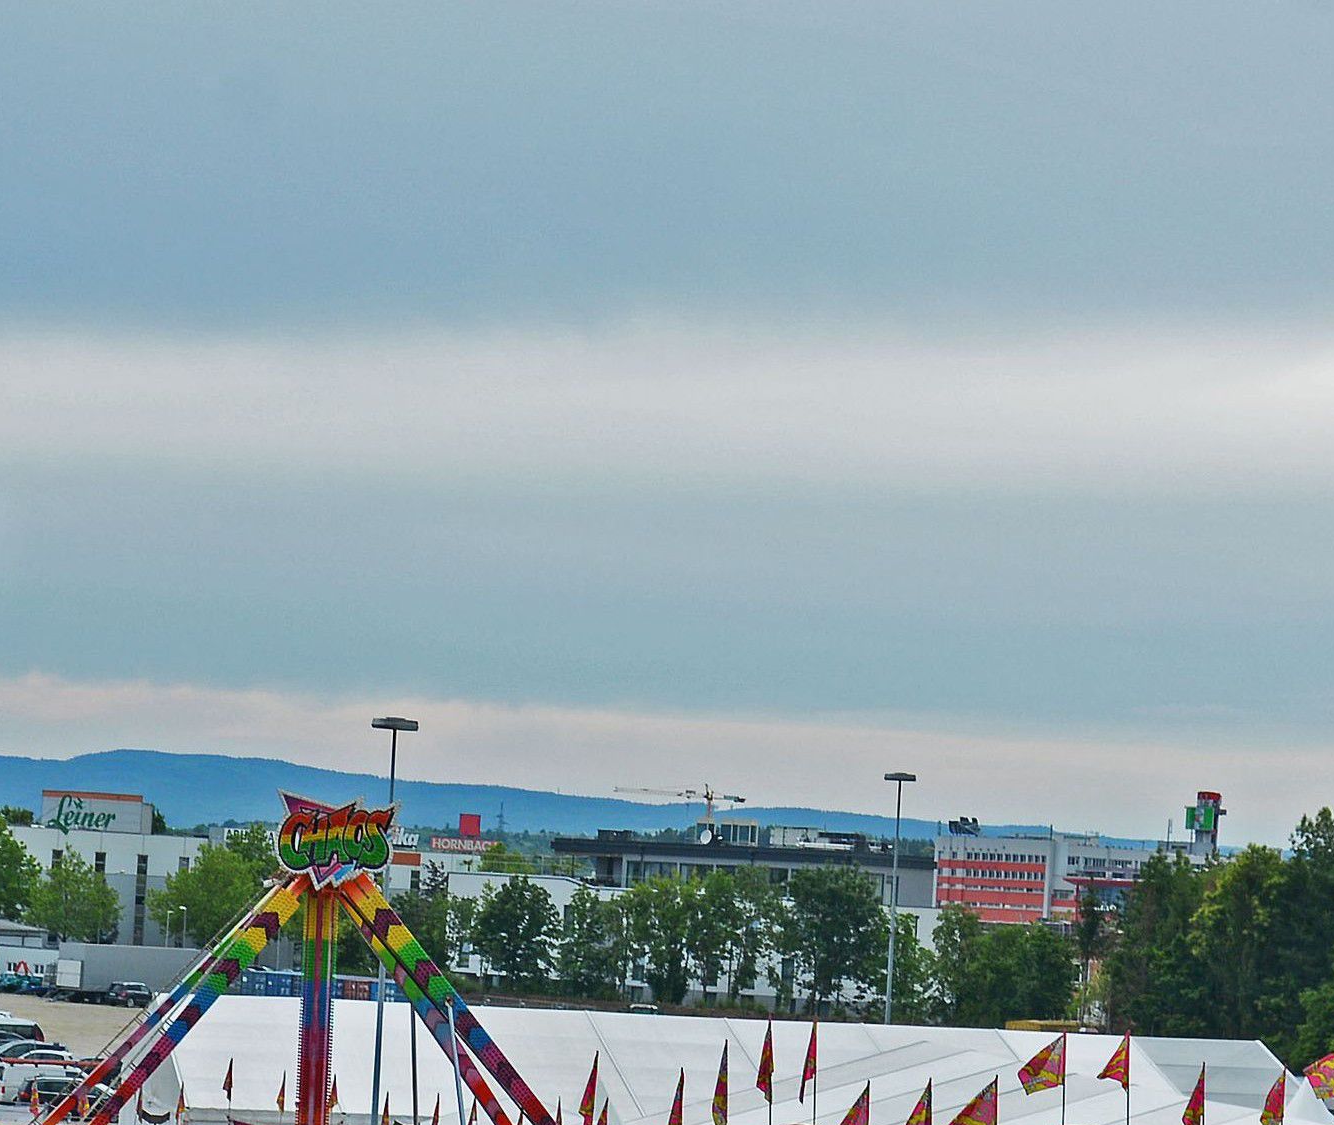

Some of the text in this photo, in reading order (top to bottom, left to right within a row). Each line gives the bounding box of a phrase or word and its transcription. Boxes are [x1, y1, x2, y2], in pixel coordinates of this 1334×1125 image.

[45, 795, 116, 835] Leiner
[278, 797, 397, 872] CHAOS
[391, 827, 419, 846] ika
[431, 837, 498, 851] HORNBAC
